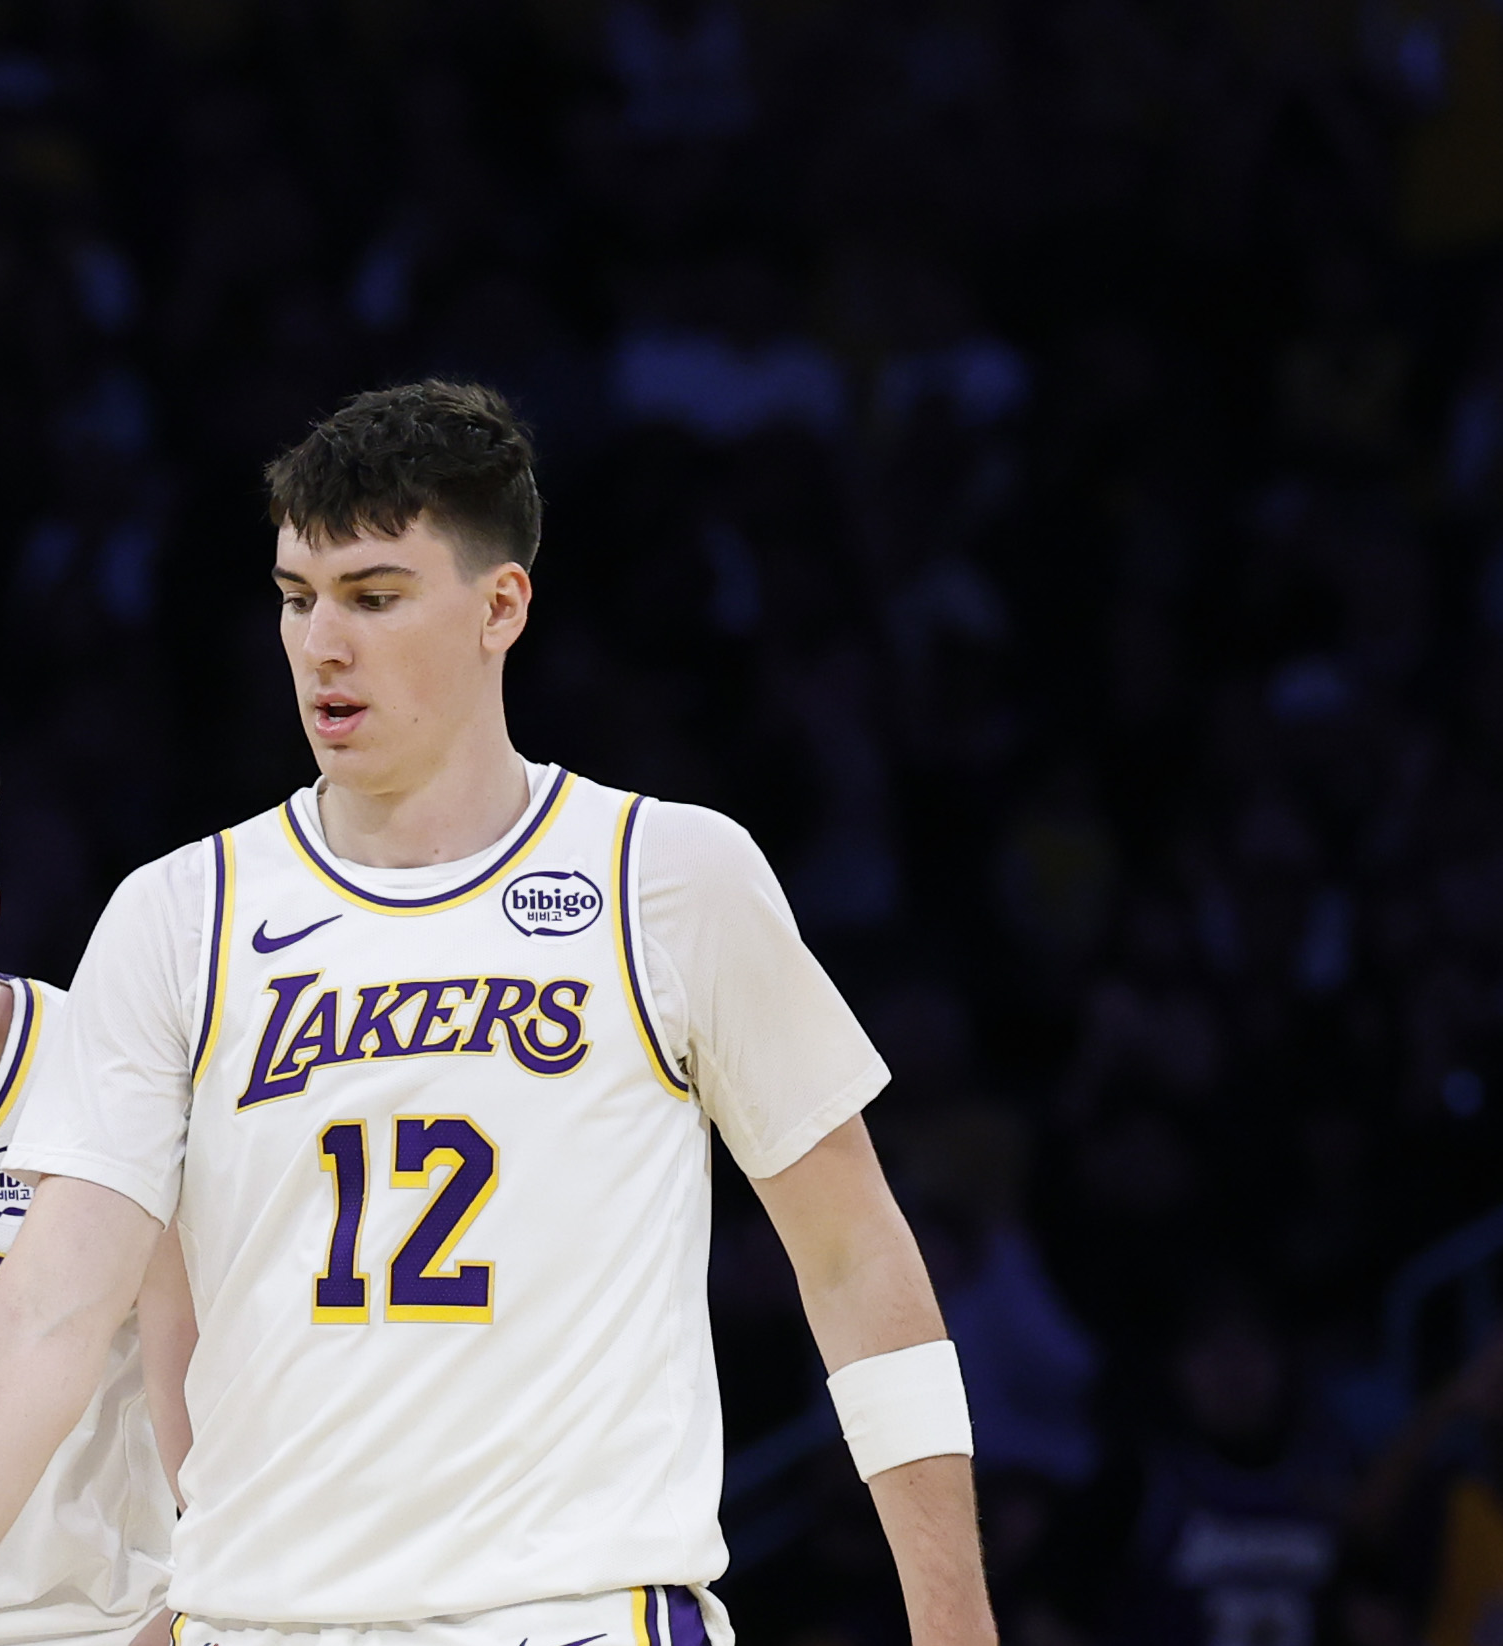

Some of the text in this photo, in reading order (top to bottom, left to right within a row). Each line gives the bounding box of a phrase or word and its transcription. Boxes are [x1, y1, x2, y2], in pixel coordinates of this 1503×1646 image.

[512, 888, 597, 918] bibigo
[235, 968, 594, 1114] LAKERS
[311, 1113, 500, 1325] 12
